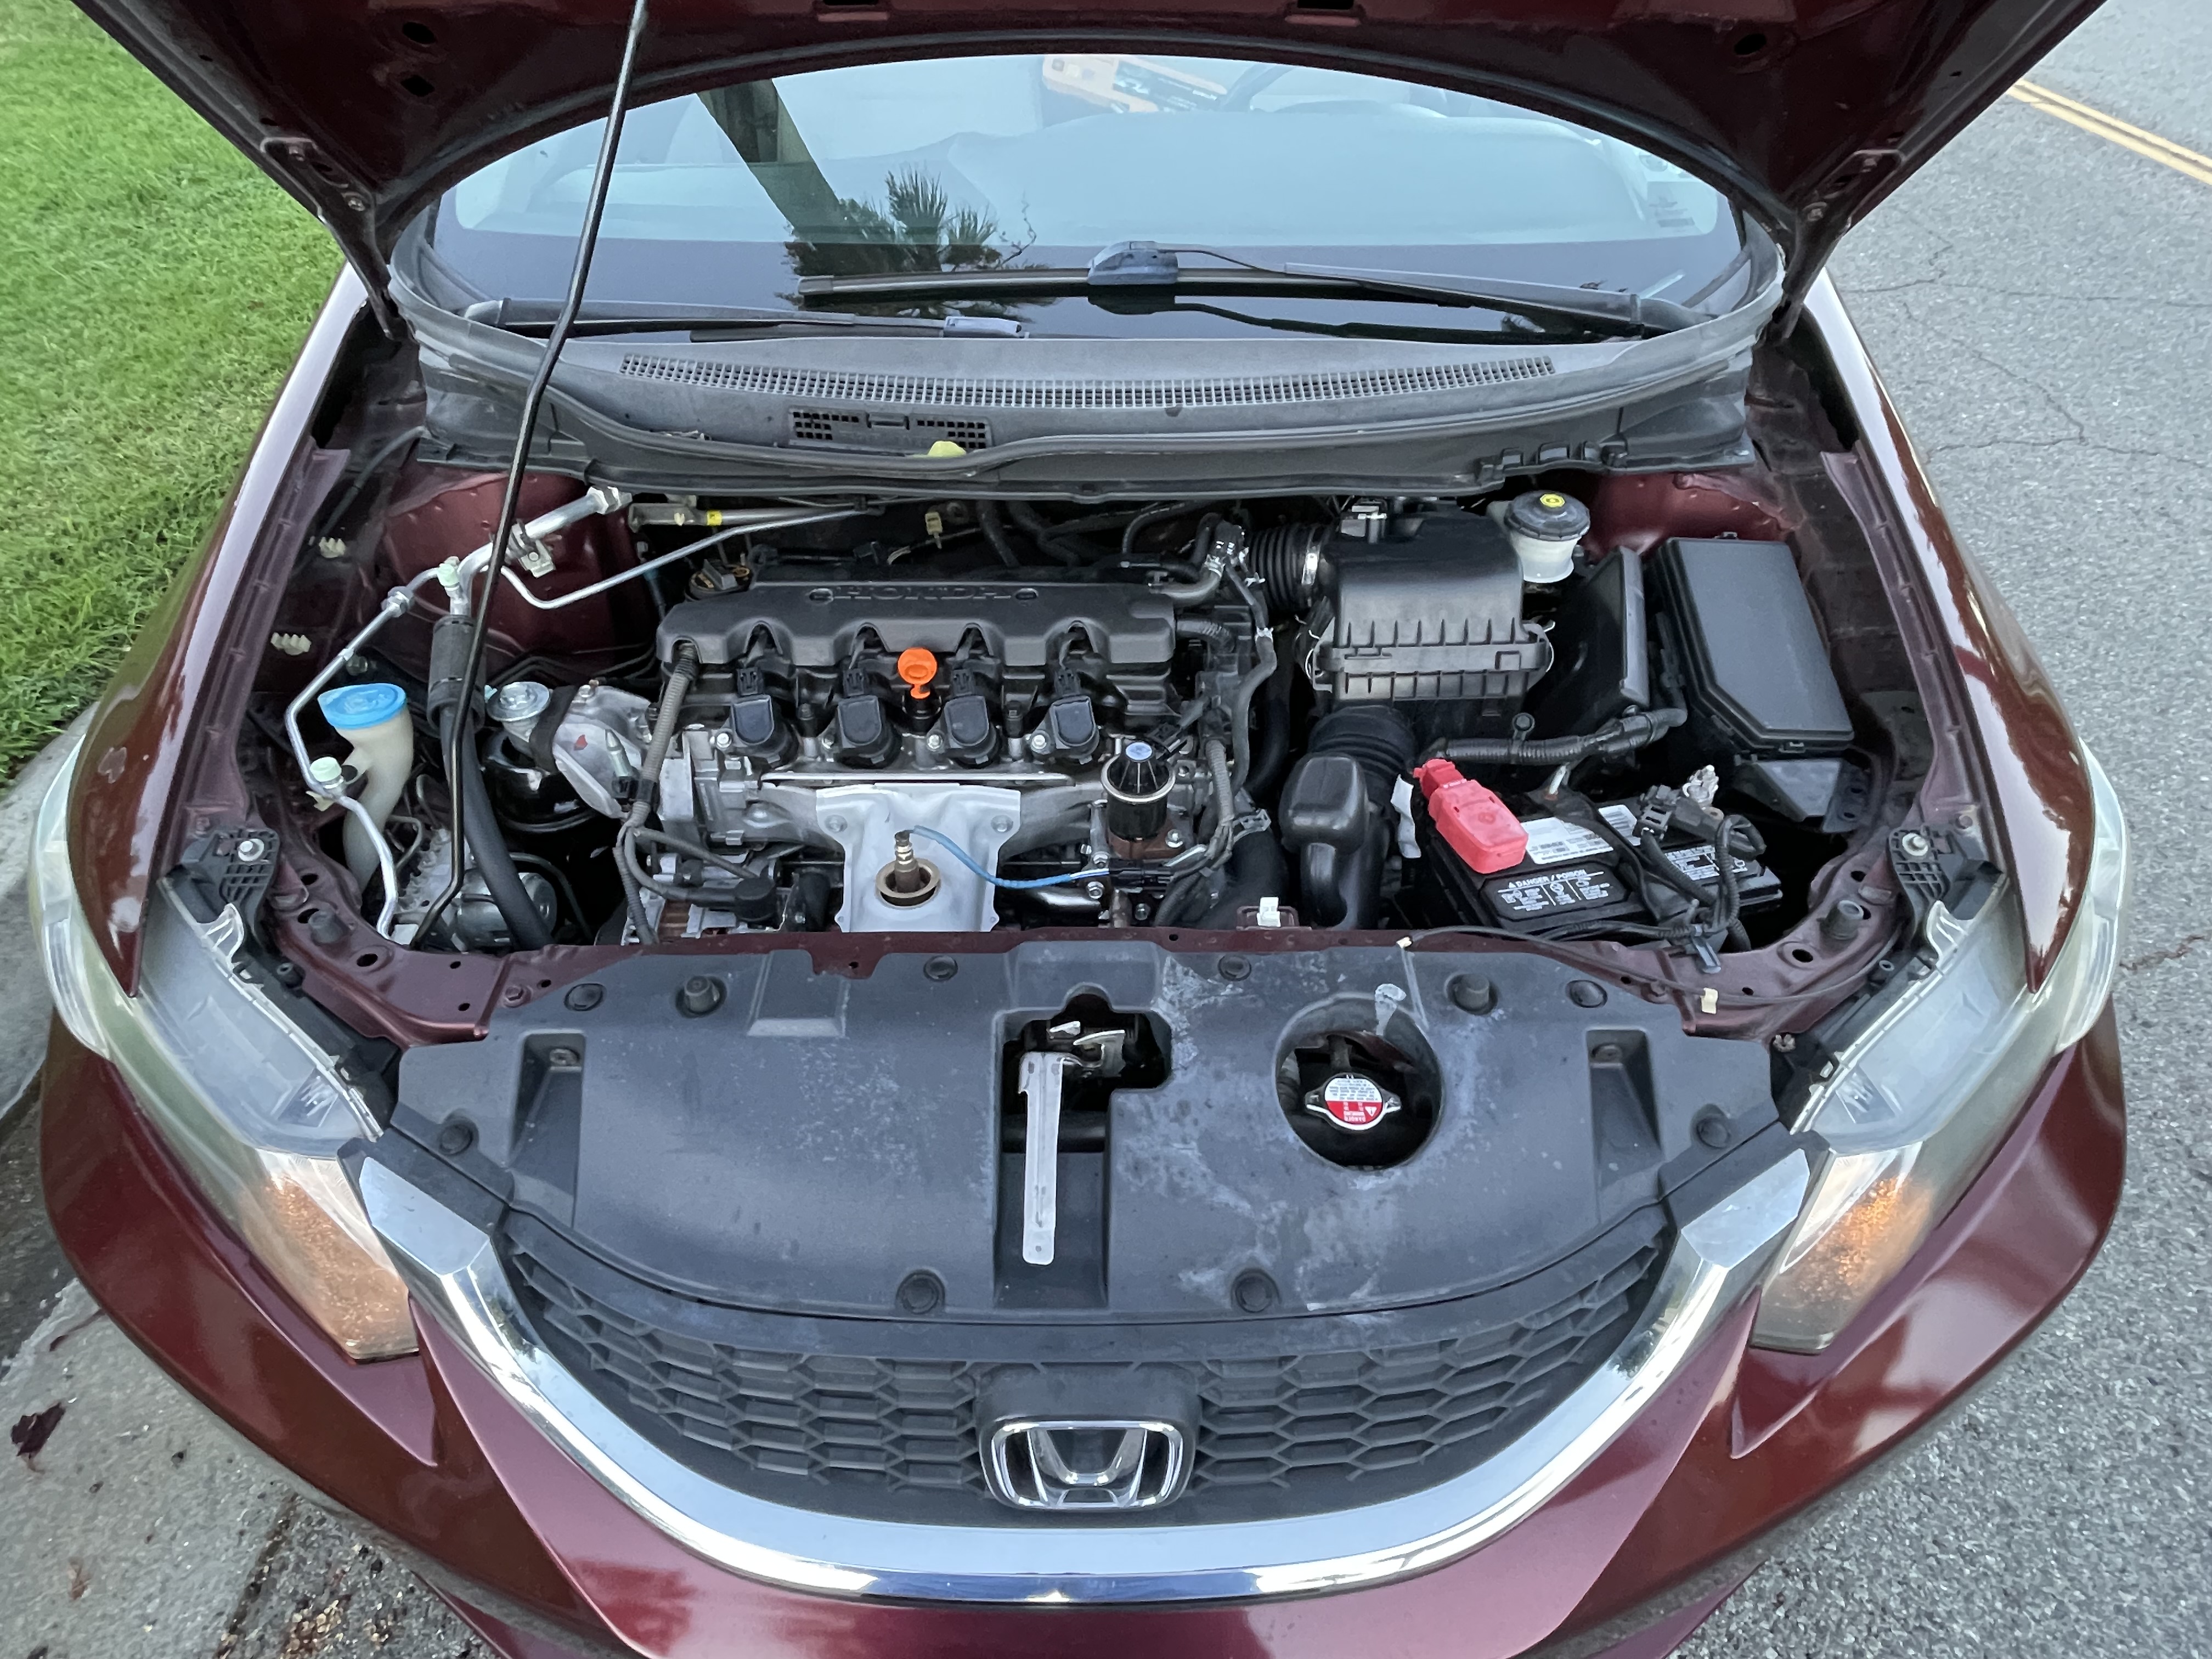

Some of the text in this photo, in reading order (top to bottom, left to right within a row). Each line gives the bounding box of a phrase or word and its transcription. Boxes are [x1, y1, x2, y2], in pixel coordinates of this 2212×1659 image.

[833, 586, 1012, 600] HONDA
[1515, 876, 1550, 887] DANGER
[1556, 869, 1587, 879] POISON
